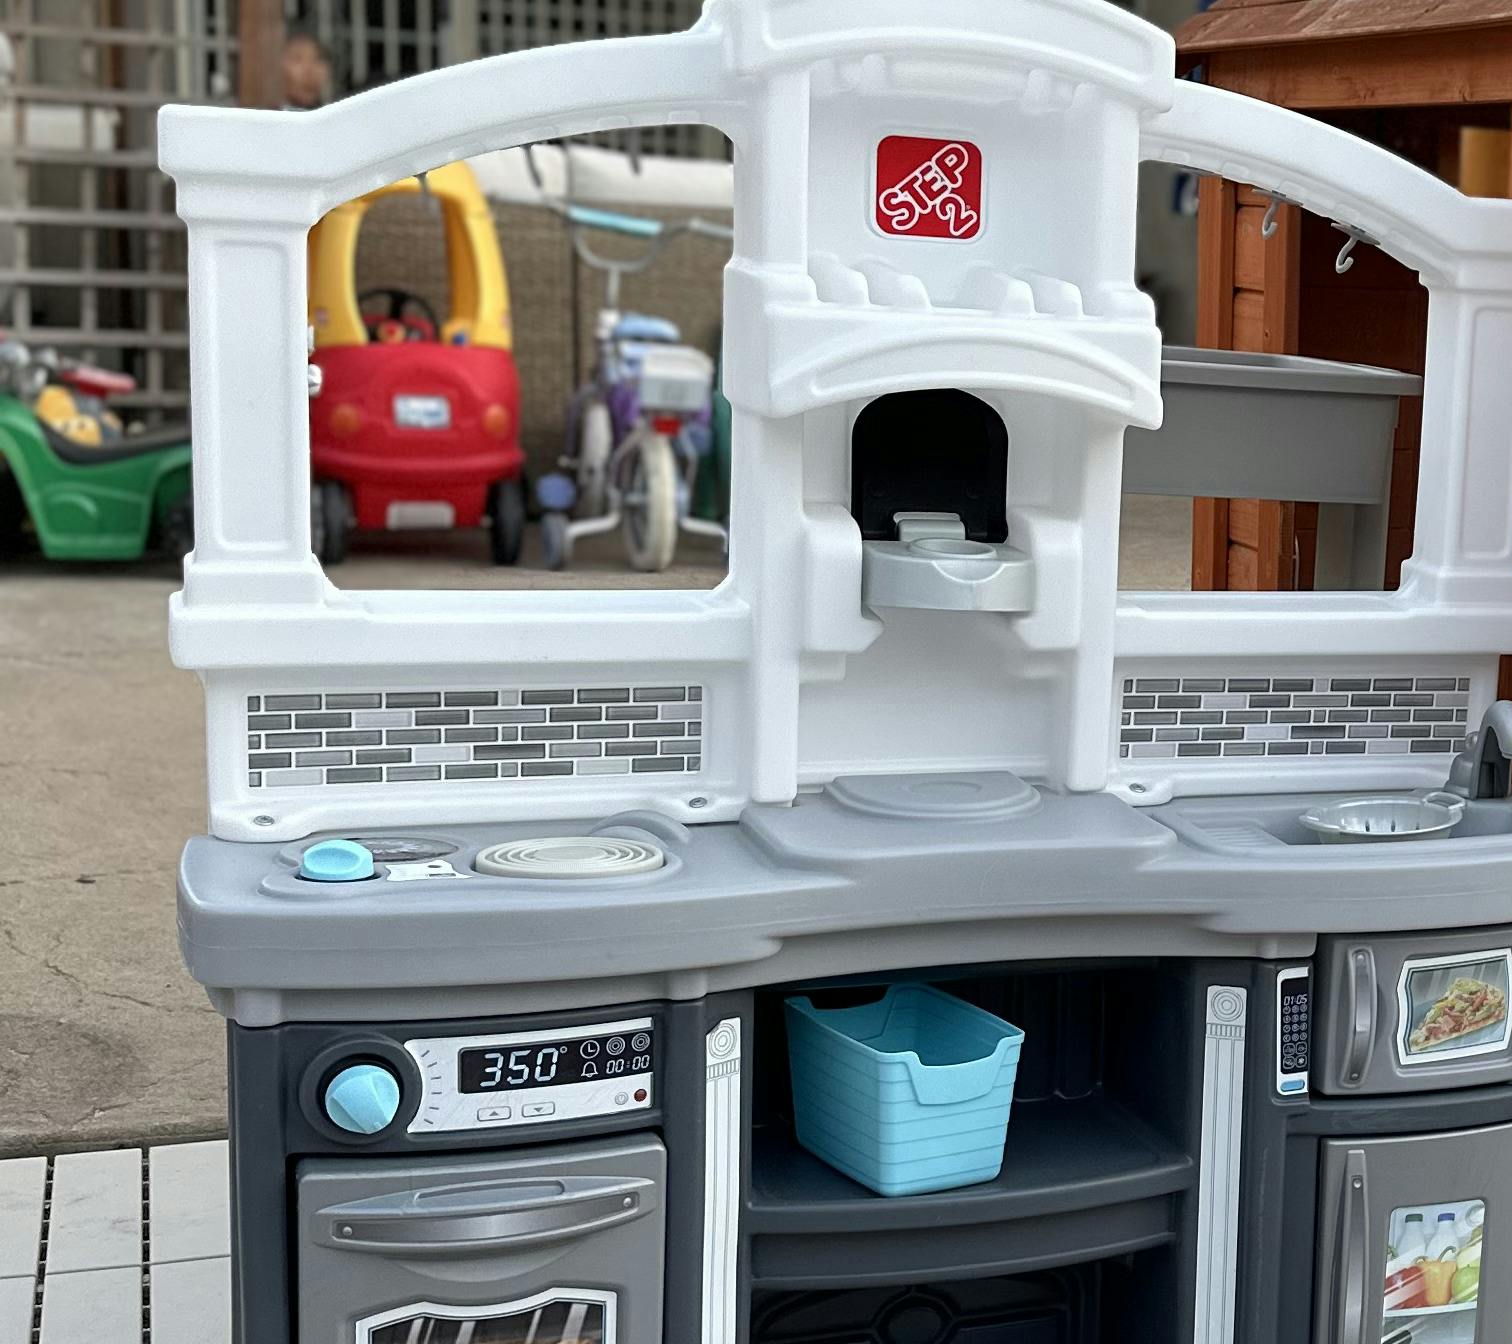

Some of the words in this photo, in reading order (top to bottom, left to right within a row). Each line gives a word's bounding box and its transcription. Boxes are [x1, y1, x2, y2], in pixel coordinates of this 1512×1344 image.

[879, 143, 969, 231] STEP
[936, 193, 978, 236] 2
[605, 1054, 650, 1074] 00:00
